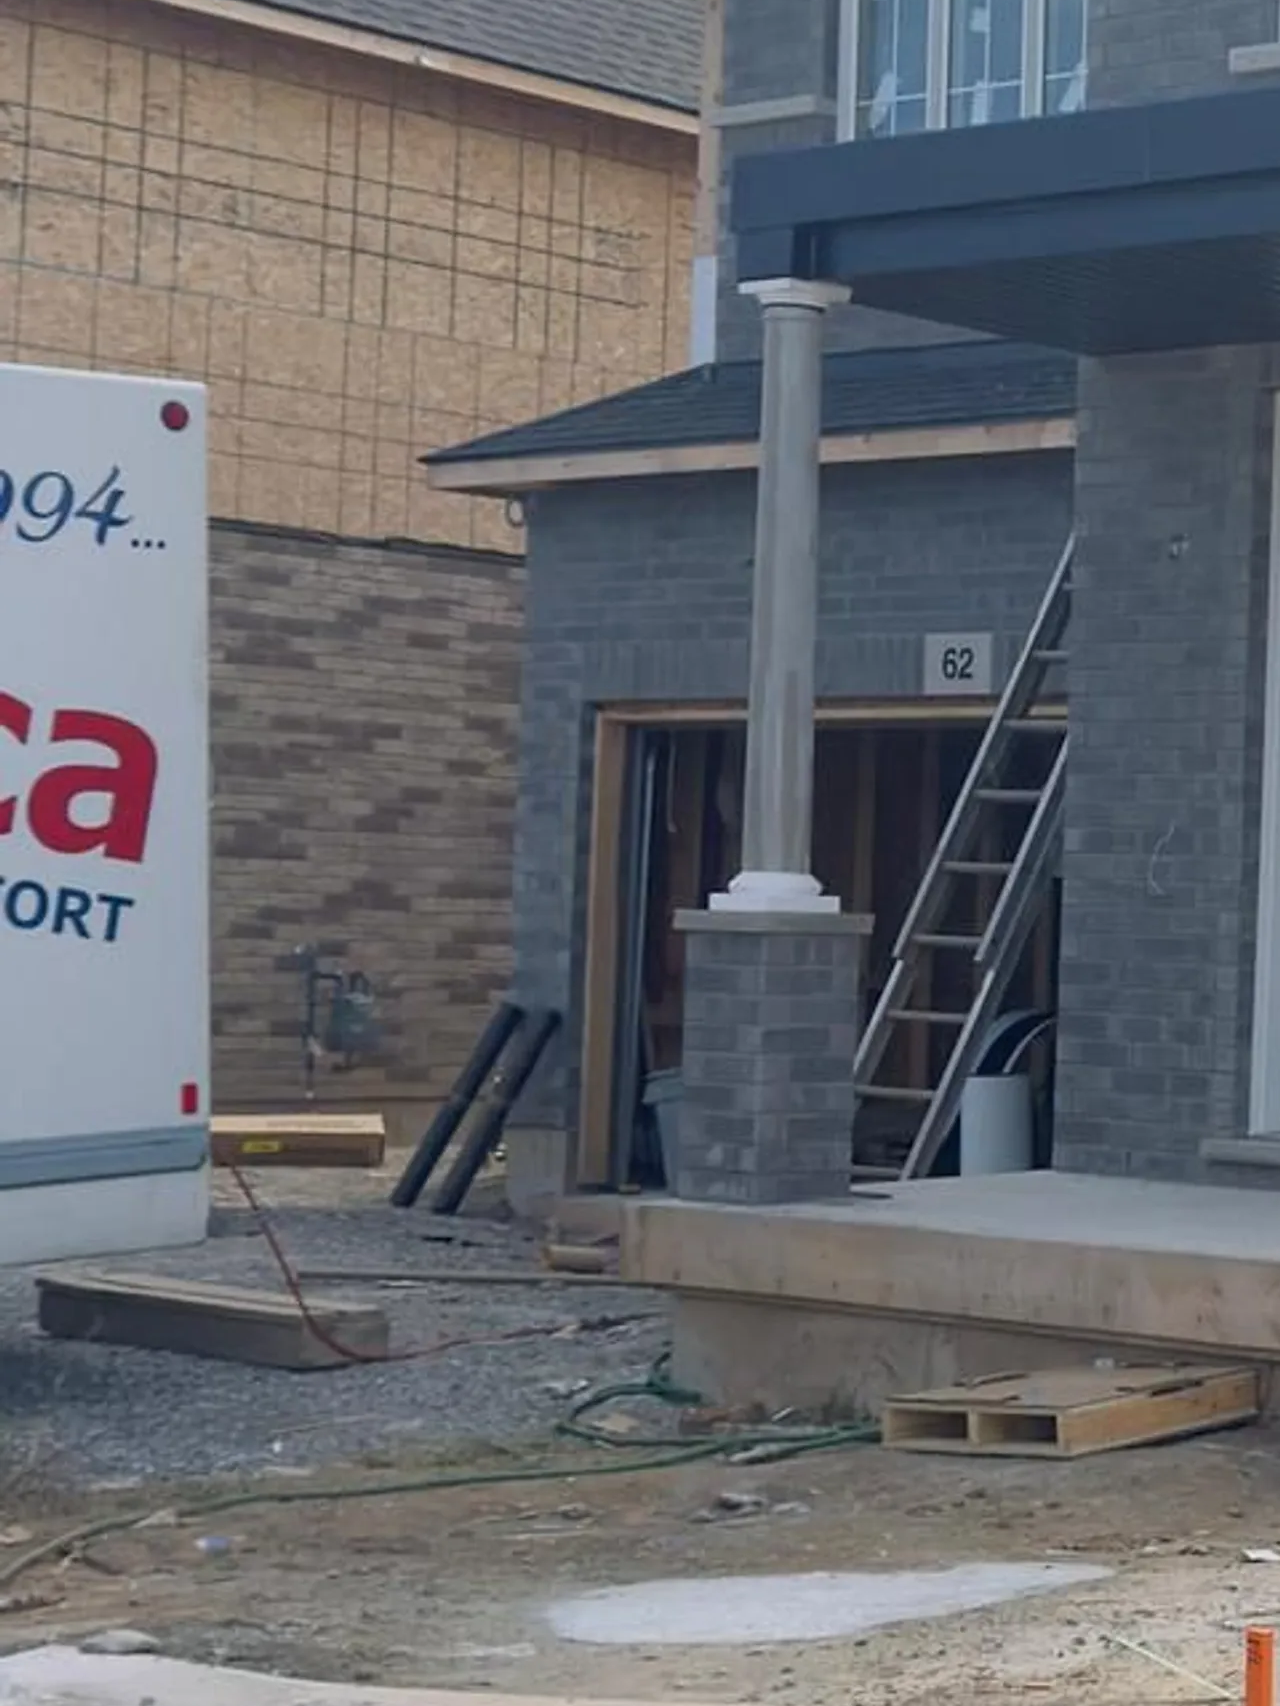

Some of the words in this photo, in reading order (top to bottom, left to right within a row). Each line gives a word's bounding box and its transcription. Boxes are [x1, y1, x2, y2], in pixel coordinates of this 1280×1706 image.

[0, 466, 166, 549] 94...
[943, 647, 973, 680] 62
[0, 876, 135, 942] ORT
